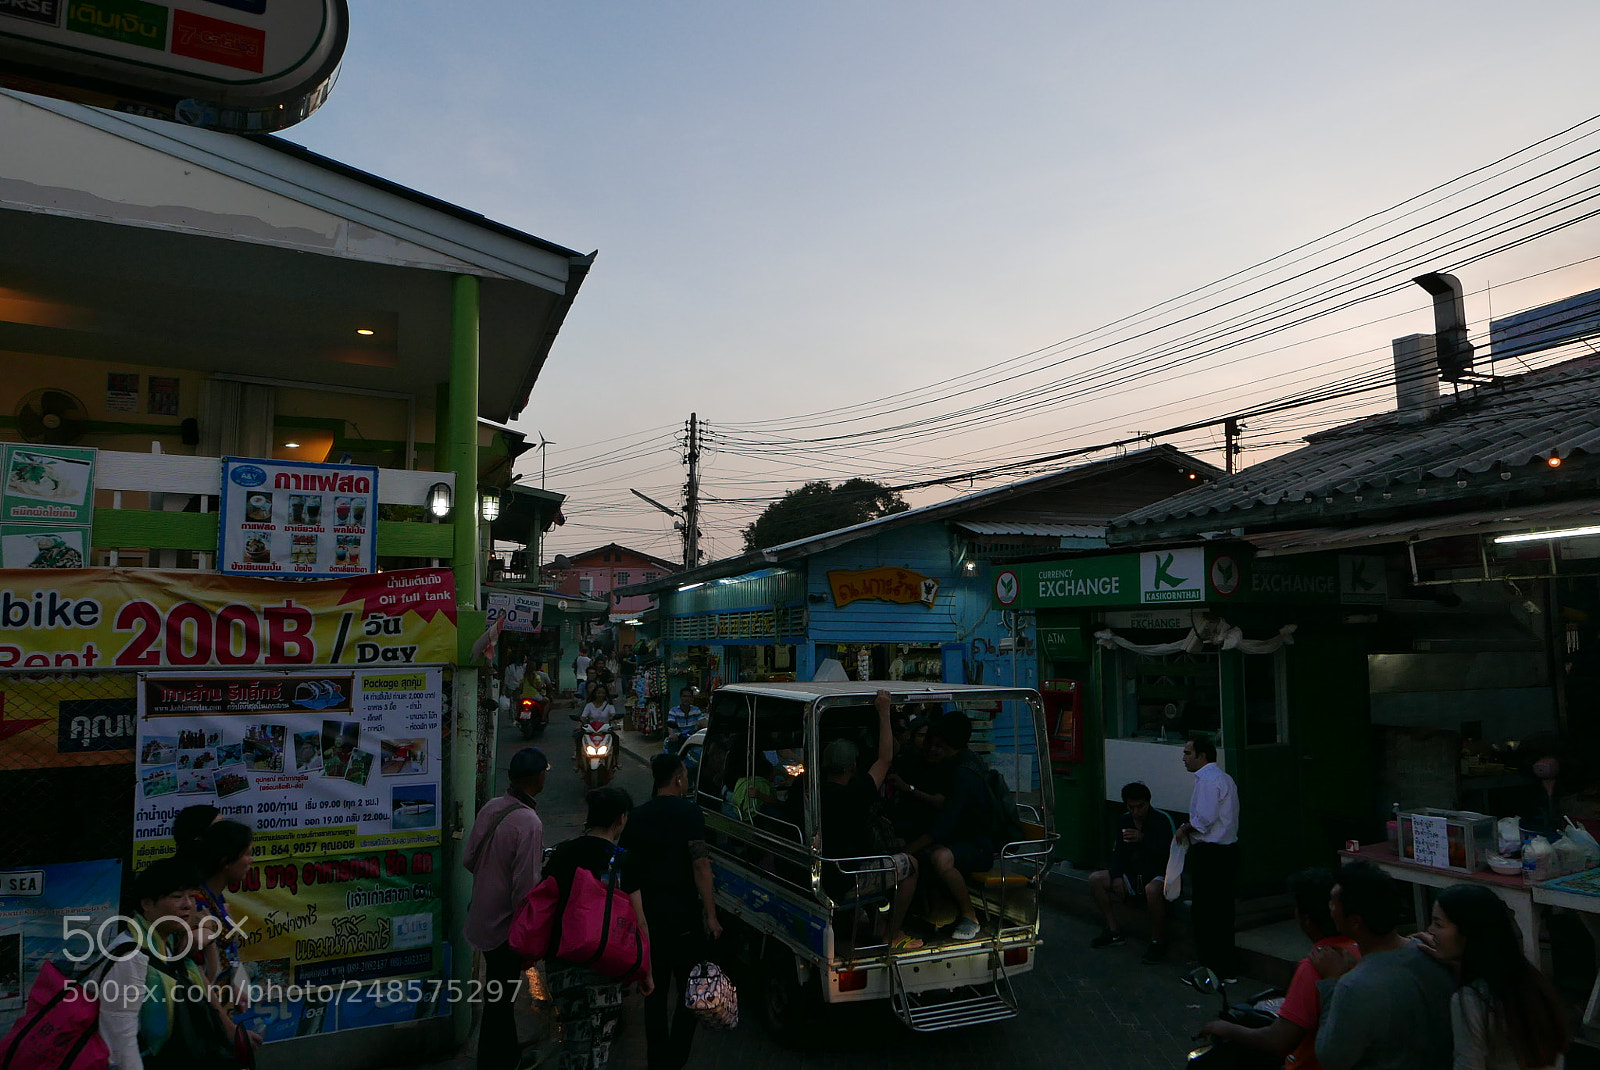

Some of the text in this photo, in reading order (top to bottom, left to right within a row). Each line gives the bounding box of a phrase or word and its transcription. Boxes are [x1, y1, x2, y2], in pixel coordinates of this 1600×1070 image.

[69, 3, 158, 38] เติมเงิน
[274, 472, 370, 494] กาแฟสด
[241, 522, 276, 531] กาแฟสด
[1038, 568, 1084, 581] CURRENCY
[1038, 576, 1130, 599] EXCHANGE
[1252, 574, 1335, 593] EXCHANGE
[379, 589, 452, 605] Oil full tank
[1145, 591, 1200, 602] KASIKORNTHAI
[2, 591, 99, 627] bike
[364, 613, 402, 636] วัน
[1130, 618, 1181, 629] EXCHANGE
[1047, 632, 1066, 645] ATM
[357, 643, 417, 665] Day
[160, 680, 223, 703] เกาะล้าน
[363, 678, 399, 690] Package
[408, 692, 424, 701] 2,000
[319, 800, 341, 810] 09.00
[358, 799, 363, 807] 2
[304, 818, 320, 826] ออก
[322, 815, 344, 825] 19.00
[270, 844, 290, 856] 864
[293, 841, 318, 853] 9057
[10, 877, 37, 892] SEA
